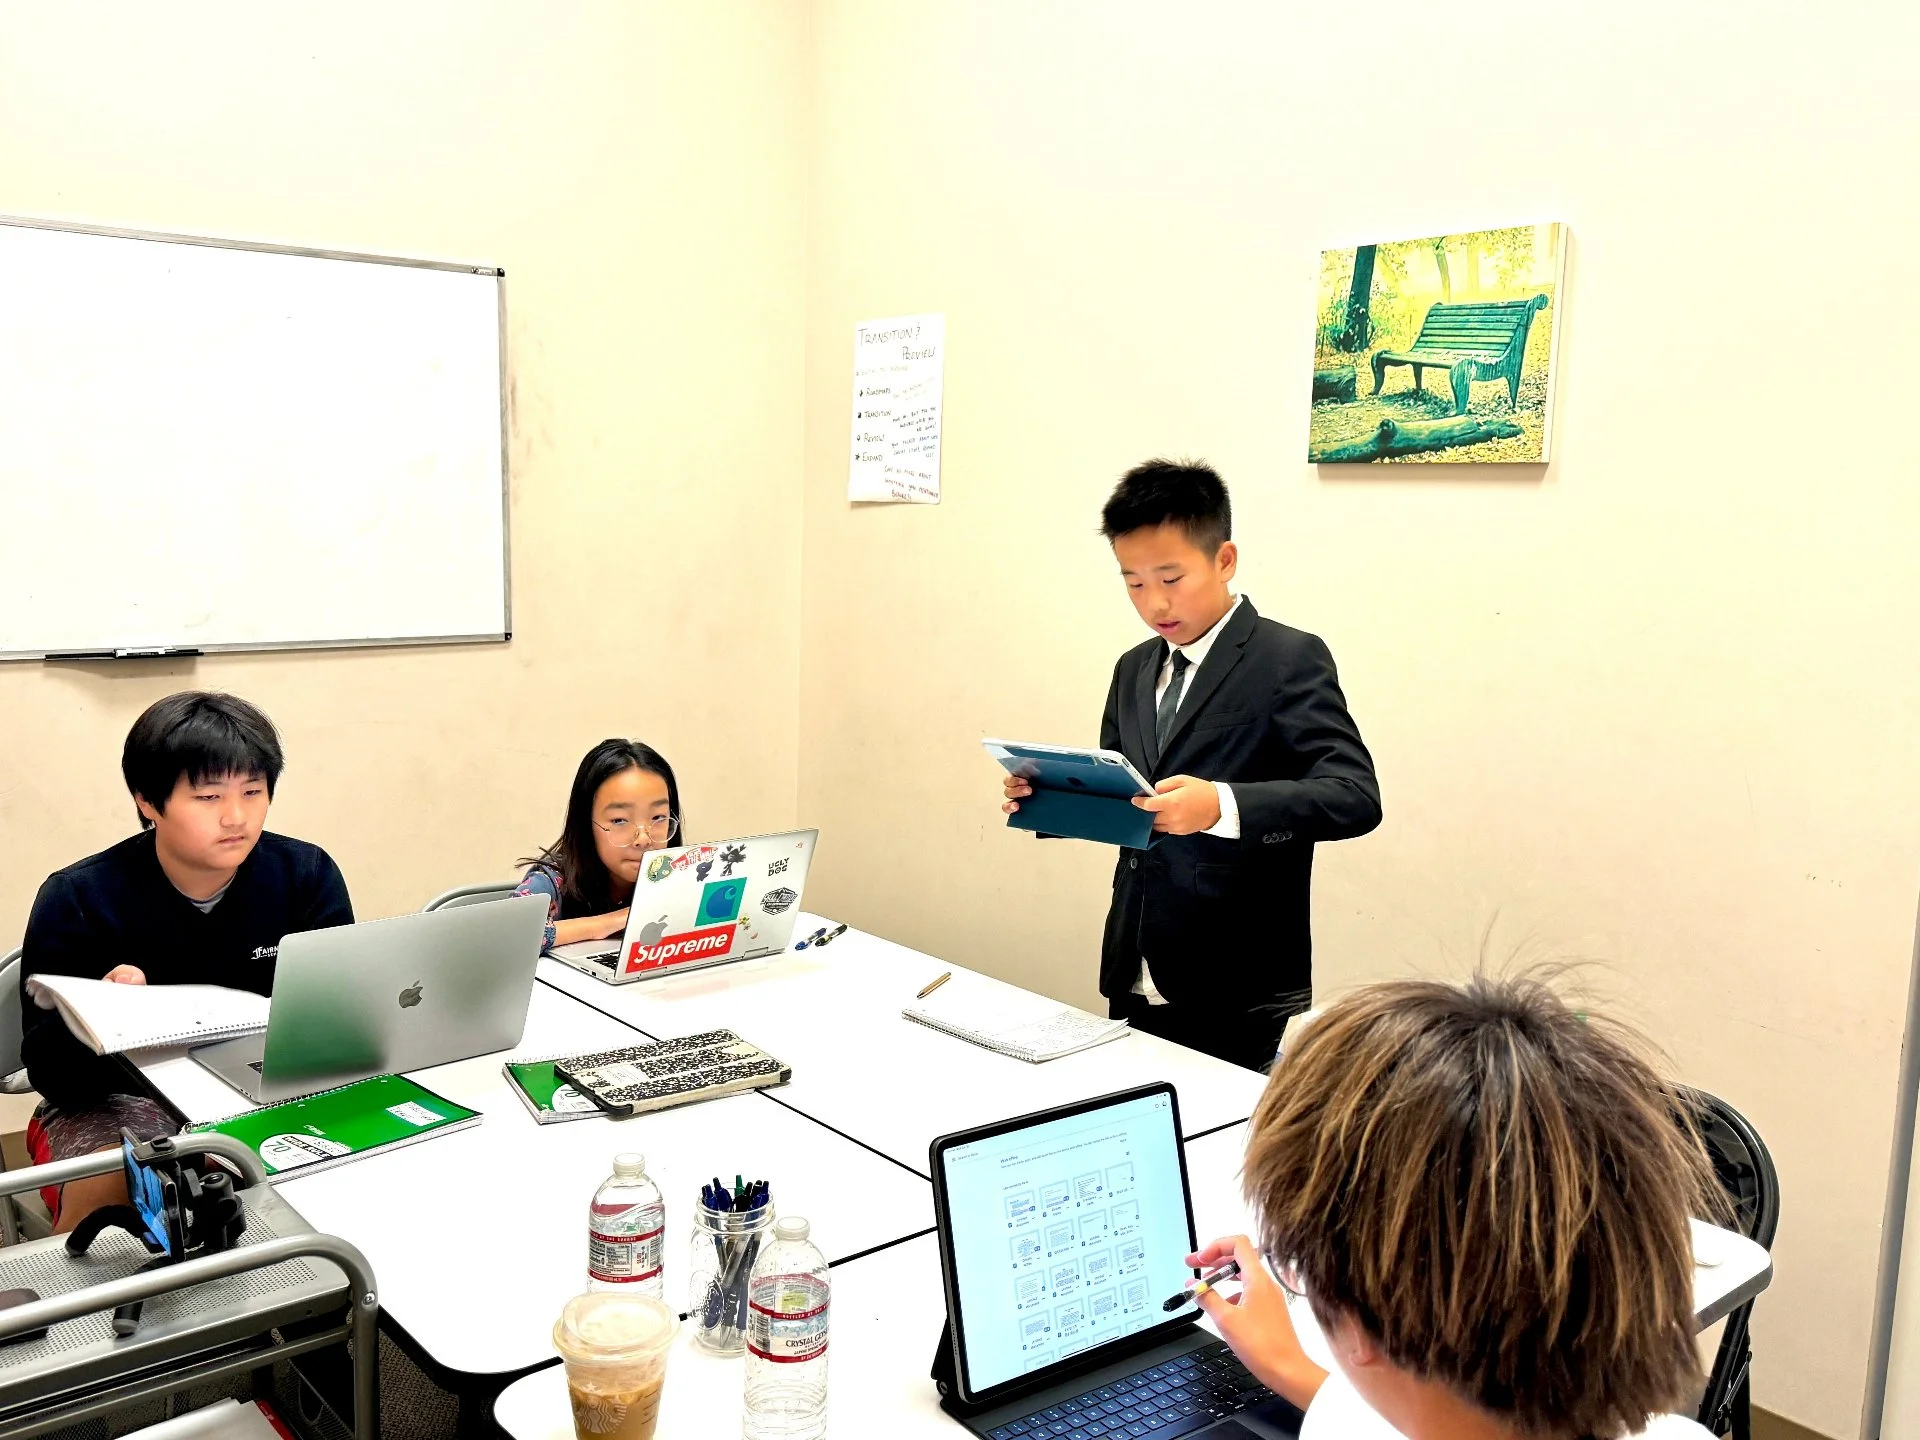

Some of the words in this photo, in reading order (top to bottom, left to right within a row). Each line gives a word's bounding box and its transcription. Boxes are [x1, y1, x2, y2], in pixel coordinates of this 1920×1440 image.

[857, 327, 913, 346] TRANSITION
[862, 451, 884, 463] EXPAND
[768, 857, 790, 869] UGLY
[768, 864, 788, 876] DOG
[633, 933, 729, 965] Supreme
[785, 1336, 814, 1348] CRYSTAL
